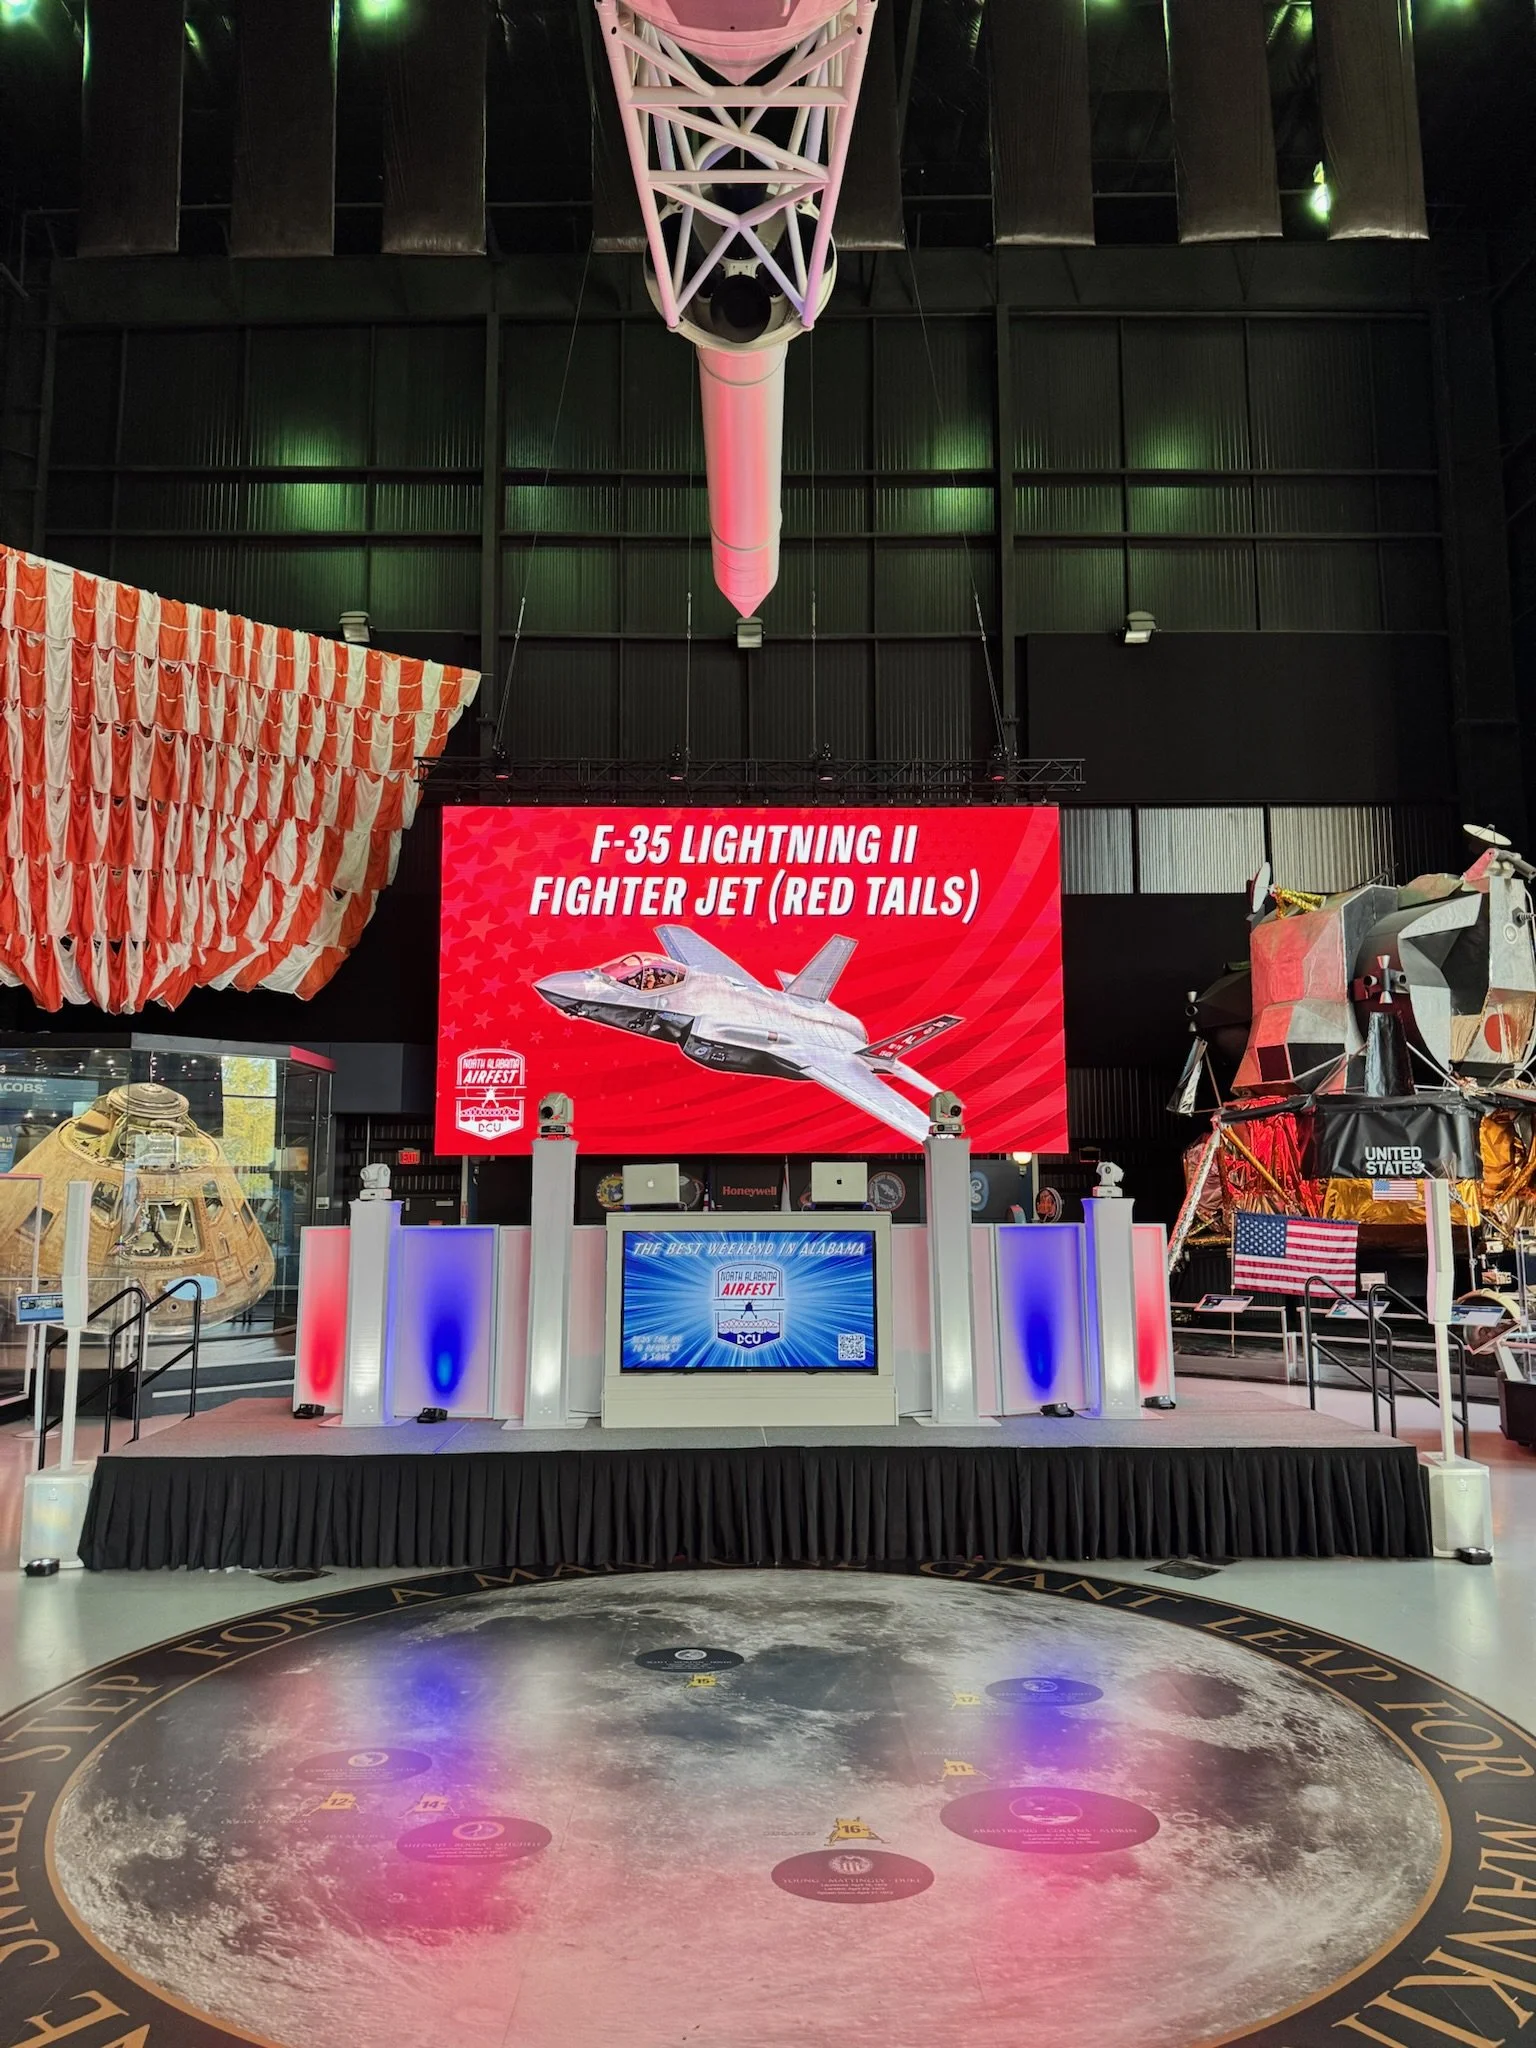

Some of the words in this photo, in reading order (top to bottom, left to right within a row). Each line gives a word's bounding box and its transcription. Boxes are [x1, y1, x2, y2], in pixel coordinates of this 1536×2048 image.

[590, 824, 672, 865] F-35
[679, 824, 879, 865] LIGHTNING
[888, 824, 918, 865] II
[528, 876, 687, 916] FIGHTER
[694, 876, 766, 917] JET
[767, 868, 861, 925] (RED
[865, 868, 980, 925] TAILS)
[463, 1058, 486, 1069] NORTH
[487, 1058, 520, 1069] ALABAMA
[463, 1070, 519, 1084] AIRFEST
[0, 1082, 44, 1094] COBS
[478, 1123, 502, 1133] DCU
[1364, 1146, 1422, 1160] UNITED
[1365, 1160, 1423, 1175] STATES
[722, 1186, 777, 1197] Honeywell
[633, 1242, 664, 1255] THE
[667, 1242, 703, 1255] BEST
[708, 1242, 774, 1256] WEEKEND
[780, 1242, 798, 1255] IN
[801, 1242, 866, 1256] ALABAMA
[721, 1271, 743, 1281] NORTH
[744, 1271, 778, 1281] ALABAMA
[722, 1283, 776, 1295] AIRFEST
[737, 1334, 761, 1345] DCU
[166, 1607, 357, 1659] FOR
[389, 1586, 444, 1604] A
[919, 1560, 1184, 1609] GIANT
[1197, 1614, 1399, 1684] LEAP
[1375, 1699, 1535, 1784] FOR
[329, 1798, 348, 1806] 12
[841, 1825, 861, 1834] 16
